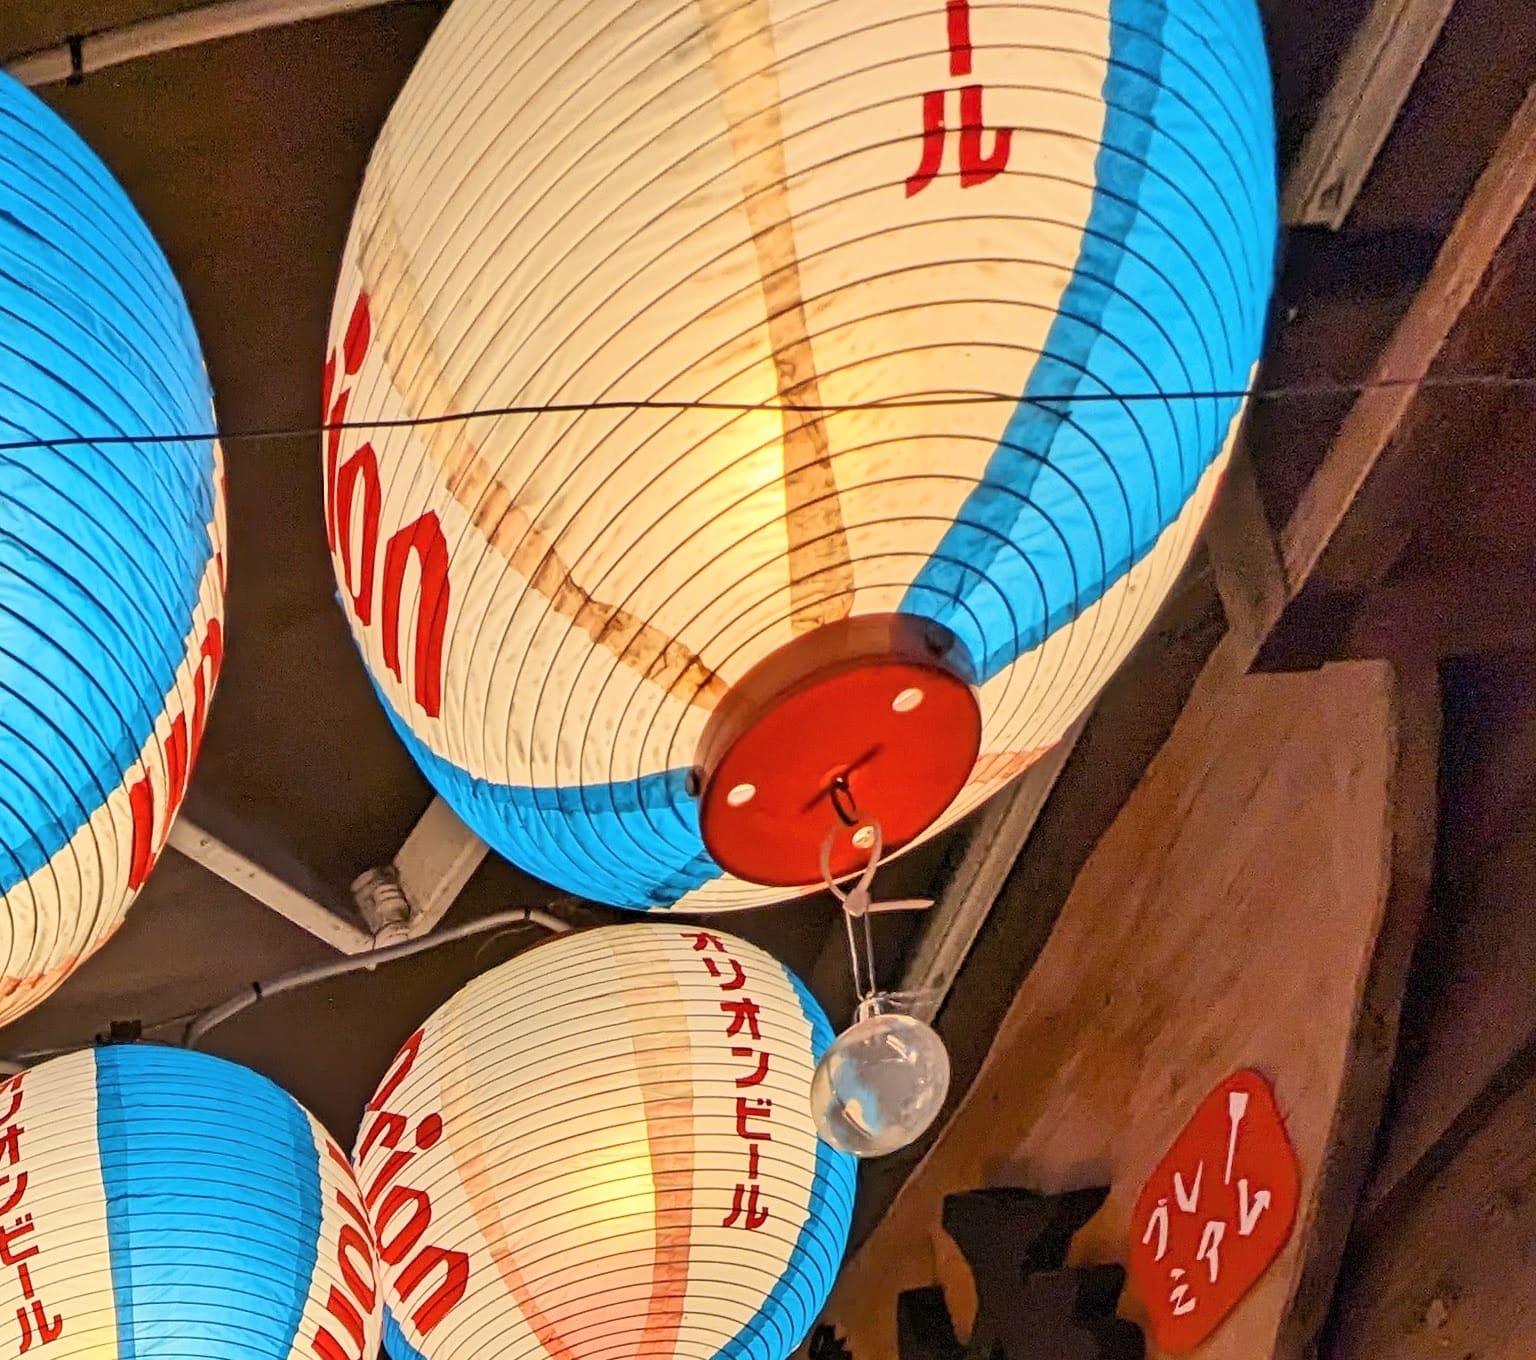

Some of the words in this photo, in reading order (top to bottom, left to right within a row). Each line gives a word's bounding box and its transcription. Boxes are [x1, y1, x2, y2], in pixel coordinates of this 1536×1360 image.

[675, 932, 771, 1236] オリオンビール
